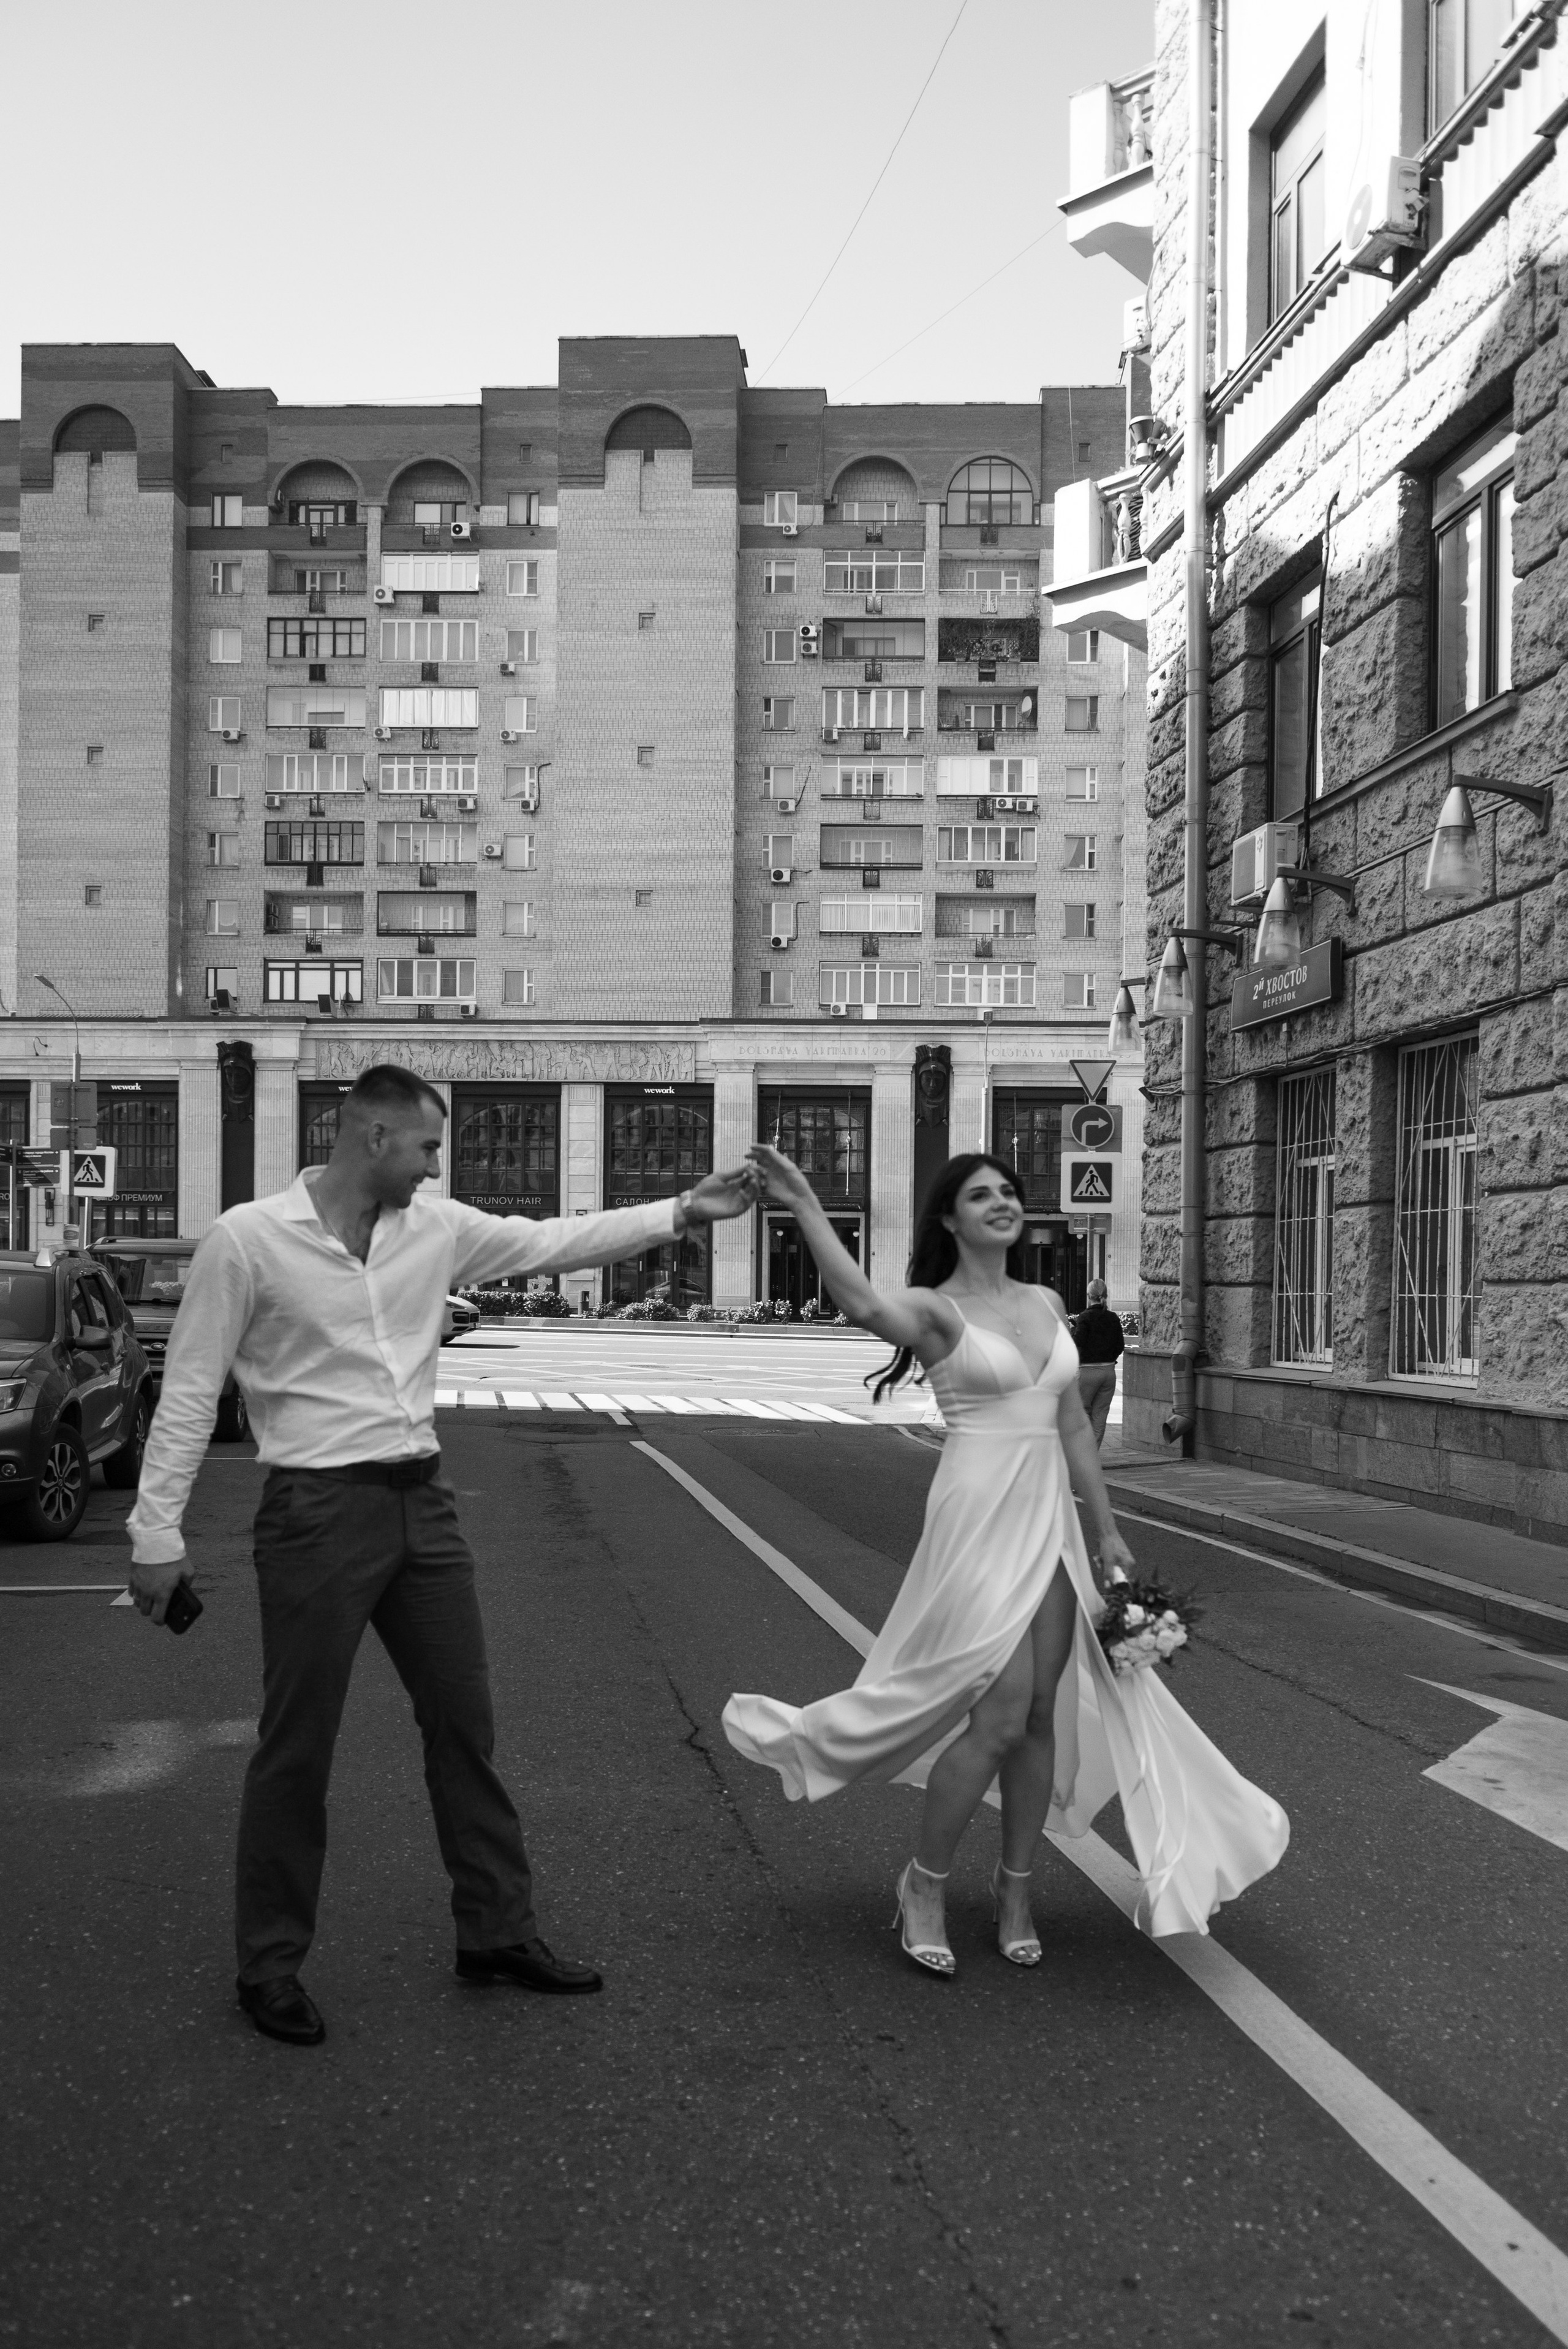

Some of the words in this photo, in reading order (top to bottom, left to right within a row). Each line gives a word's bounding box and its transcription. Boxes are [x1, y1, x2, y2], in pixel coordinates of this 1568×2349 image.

[1265, 966, 1307, 996] ХВОСТОВ
[1263, 991, 1296, 1009] ПЕРЕУЛОК
[739, 1046, 798, 1055] BOLSHAYA
[805, 1046, 866, 1055] YAKIMANKA
